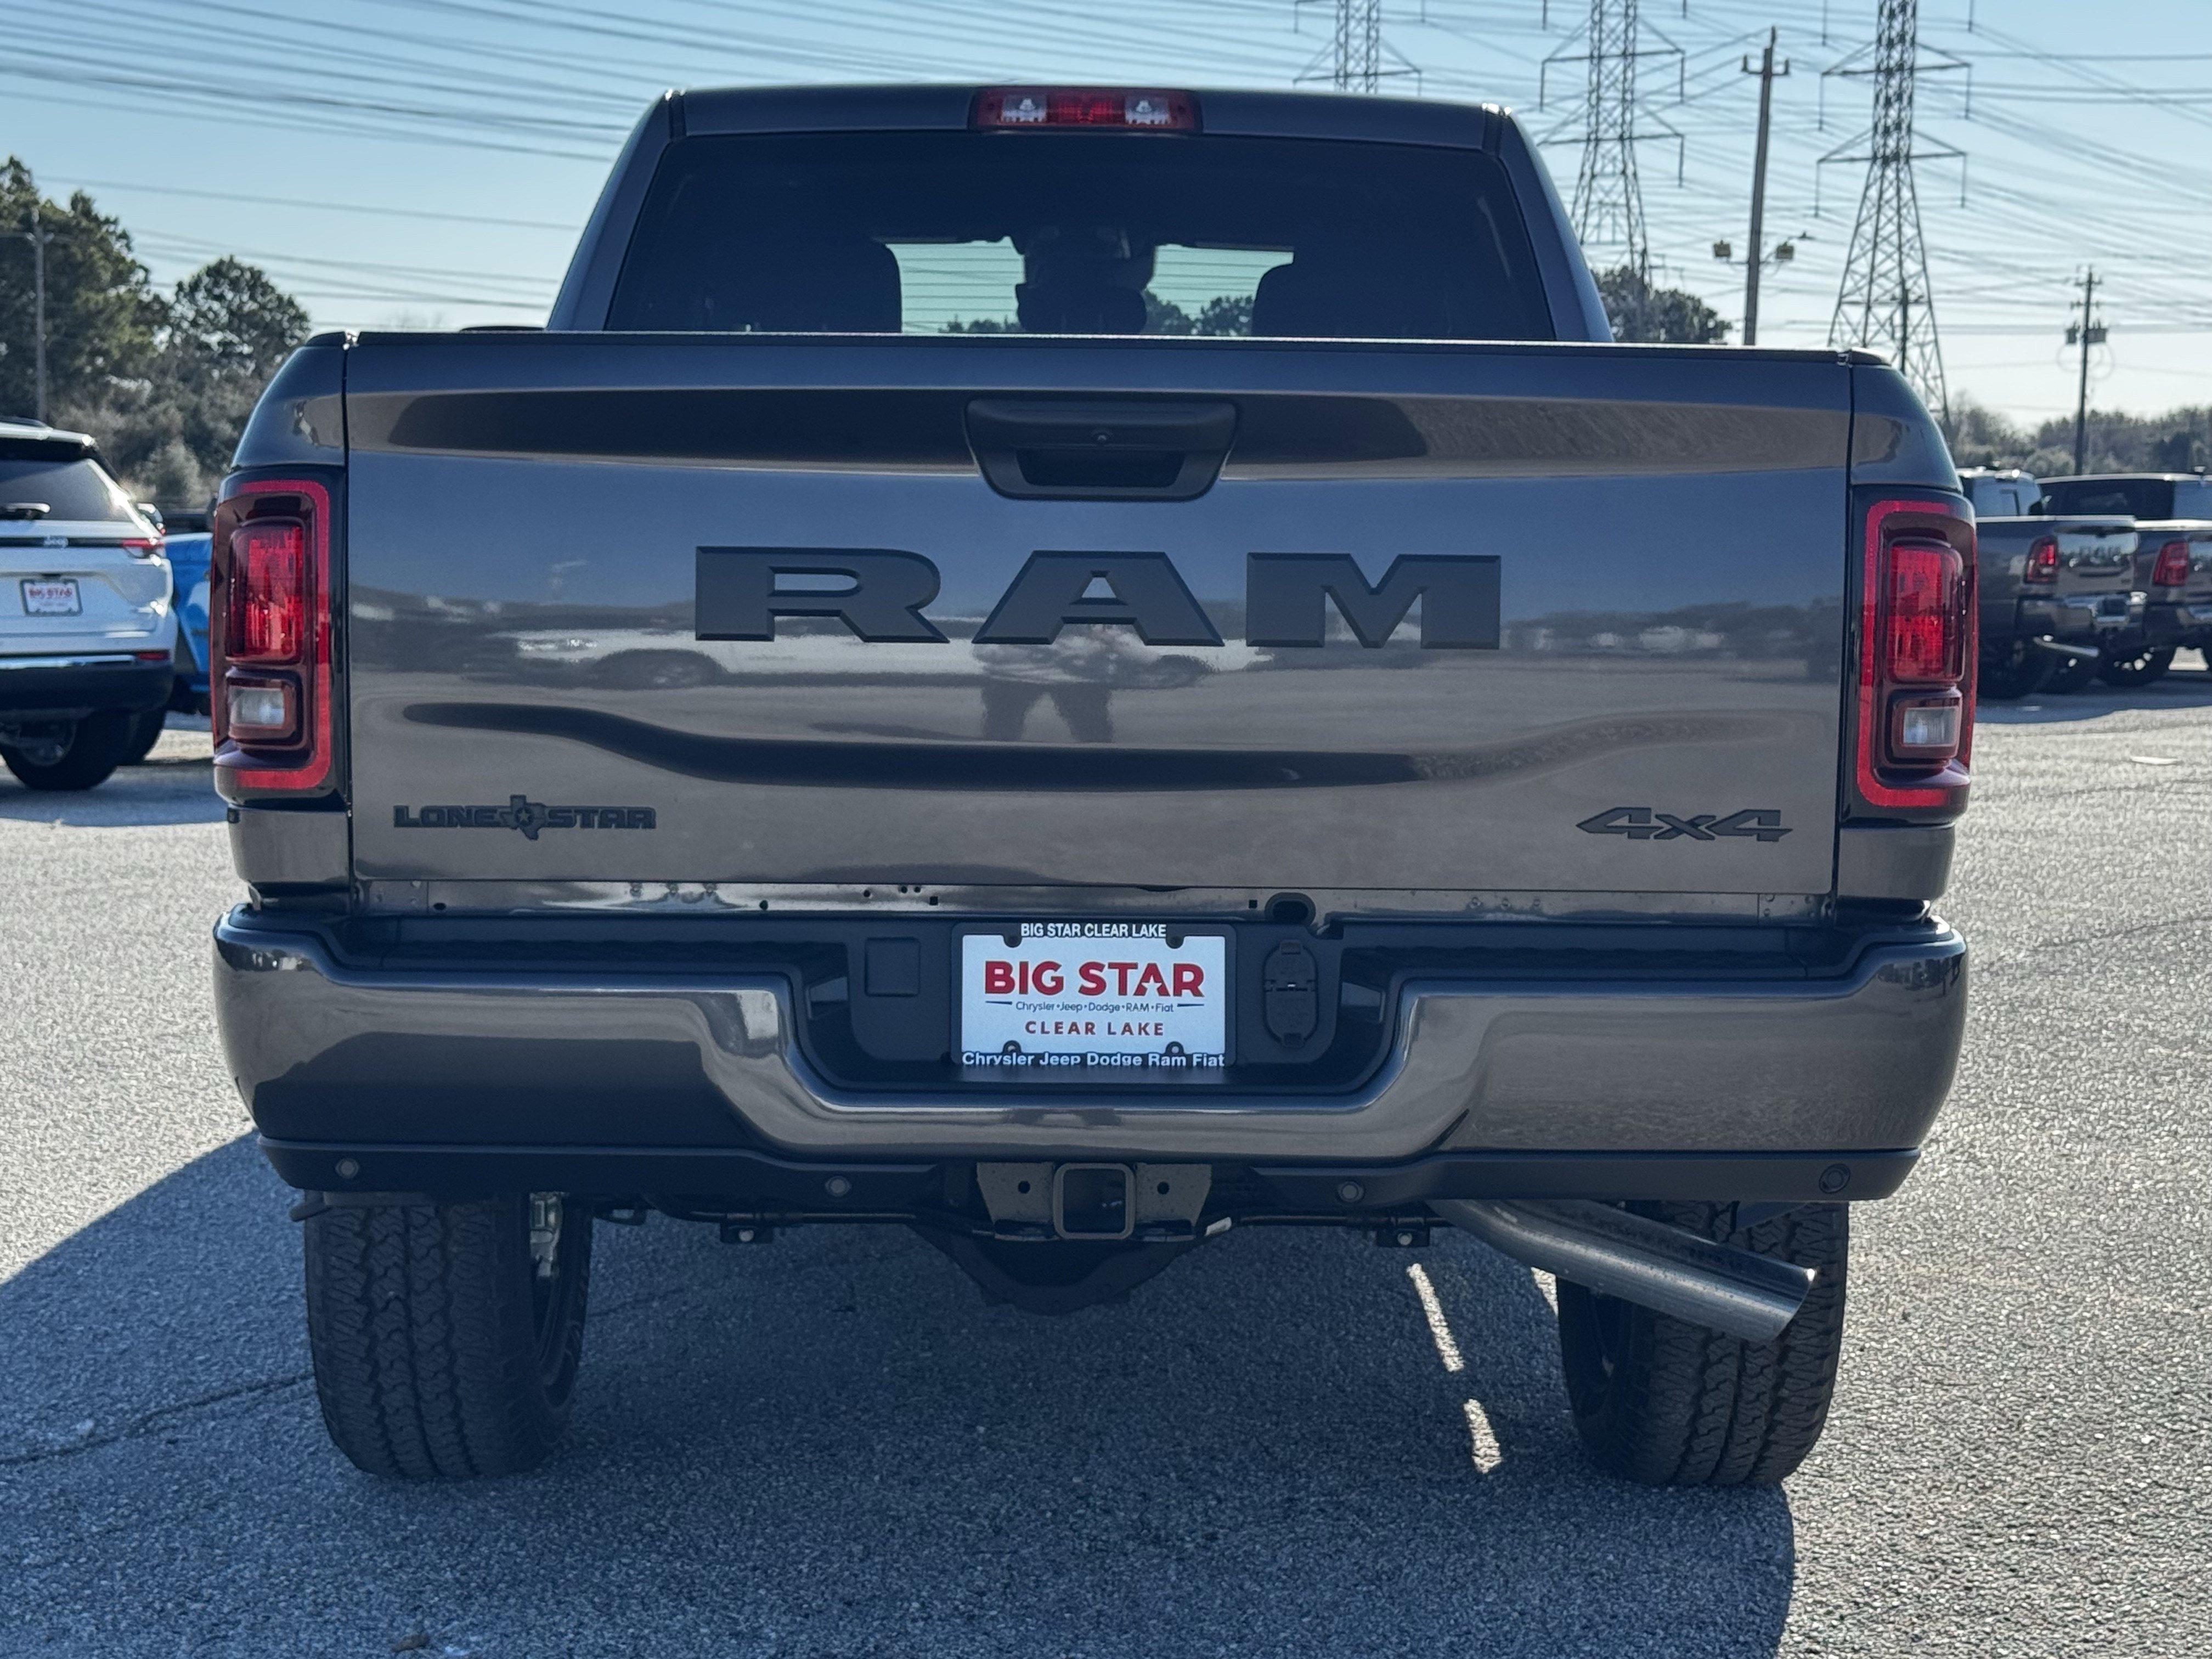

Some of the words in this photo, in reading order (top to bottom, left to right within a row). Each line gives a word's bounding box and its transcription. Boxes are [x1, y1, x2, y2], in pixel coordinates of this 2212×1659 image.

[695, 545, 1502, 650] RAM
[393, 805, 499, 828] LONE
[548, 806, 657, 829] STAR
[1020, 923, 1043, 937] BIG
[1047, 923, 1081, 937] STAR
[1085, 923, 1128, 937] CLEAR
[1132, 924, 1167, 938] LAKE
[984, 960, 1064, 996] BIG
[1077, 961, 1205, 997] STAR
[1025, 1020, 1096, 1035] CLEAR
[1107, 1022, 1164, 1036] LAKE
[962, 1052, 1034, 1066] Chrysler
[1039, 1052, 1081, 1066] Jeep
[1087, 1052, 1143, 1066] Dodge
[1148, 1053, 1186, 1067] Ram
[1192, 1053, 1225, 1067] Fiat
